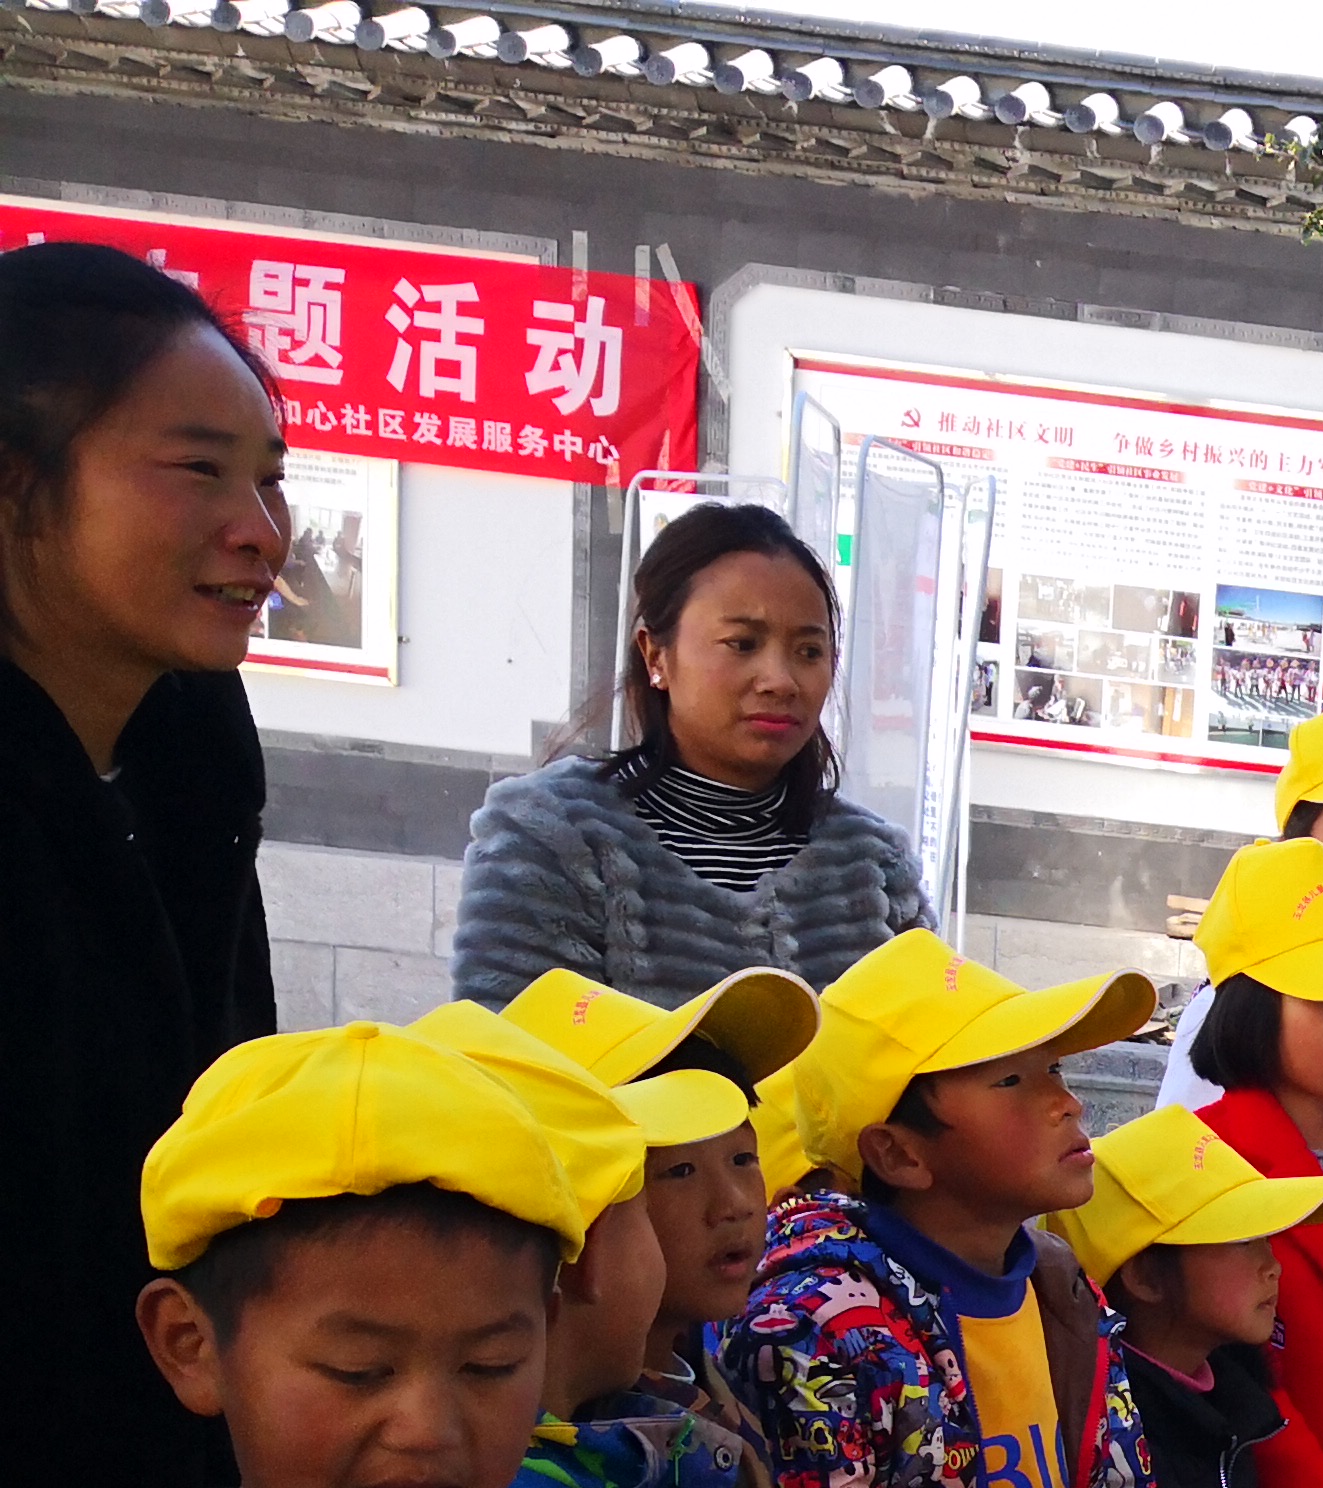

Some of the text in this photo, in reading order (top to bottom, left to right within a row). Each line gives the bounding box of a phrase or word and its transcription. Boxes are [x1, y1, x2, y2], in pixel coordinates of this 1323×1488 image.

[148, 247, 623, 416] 题活动
[938, 410, 1074, 447] 推动社区文明
